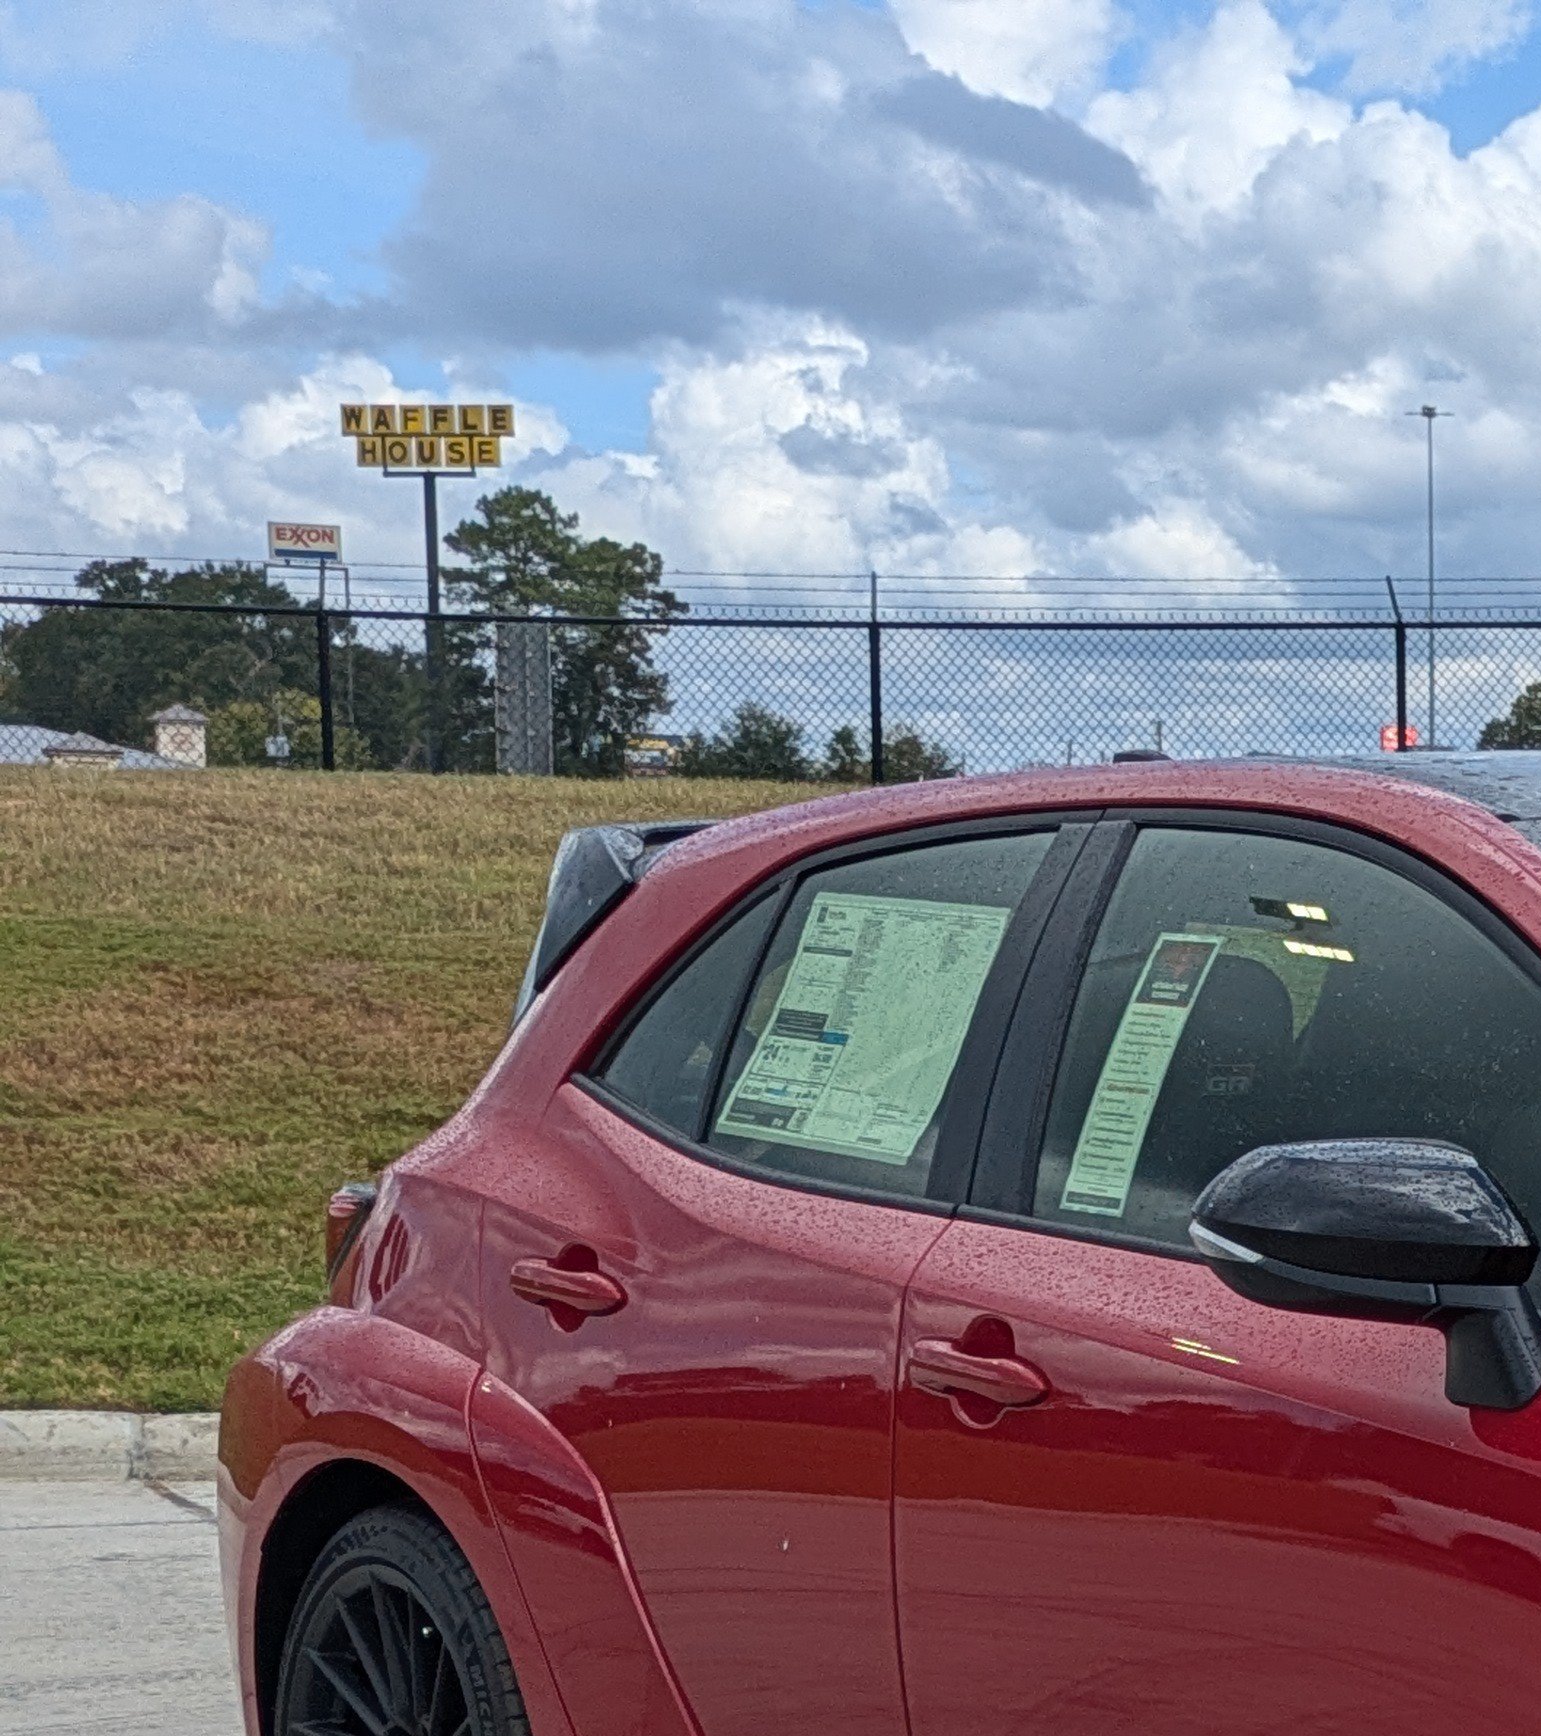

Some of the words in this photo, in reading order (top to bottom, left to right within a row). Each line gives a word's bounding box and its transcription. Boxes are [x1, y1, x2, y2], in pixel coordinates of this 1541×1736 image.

[343, 408, 507, 431] WAFFLE
[361, 440, 495, 464] HOUSE
[275, 526, 335, 548] EXXON
